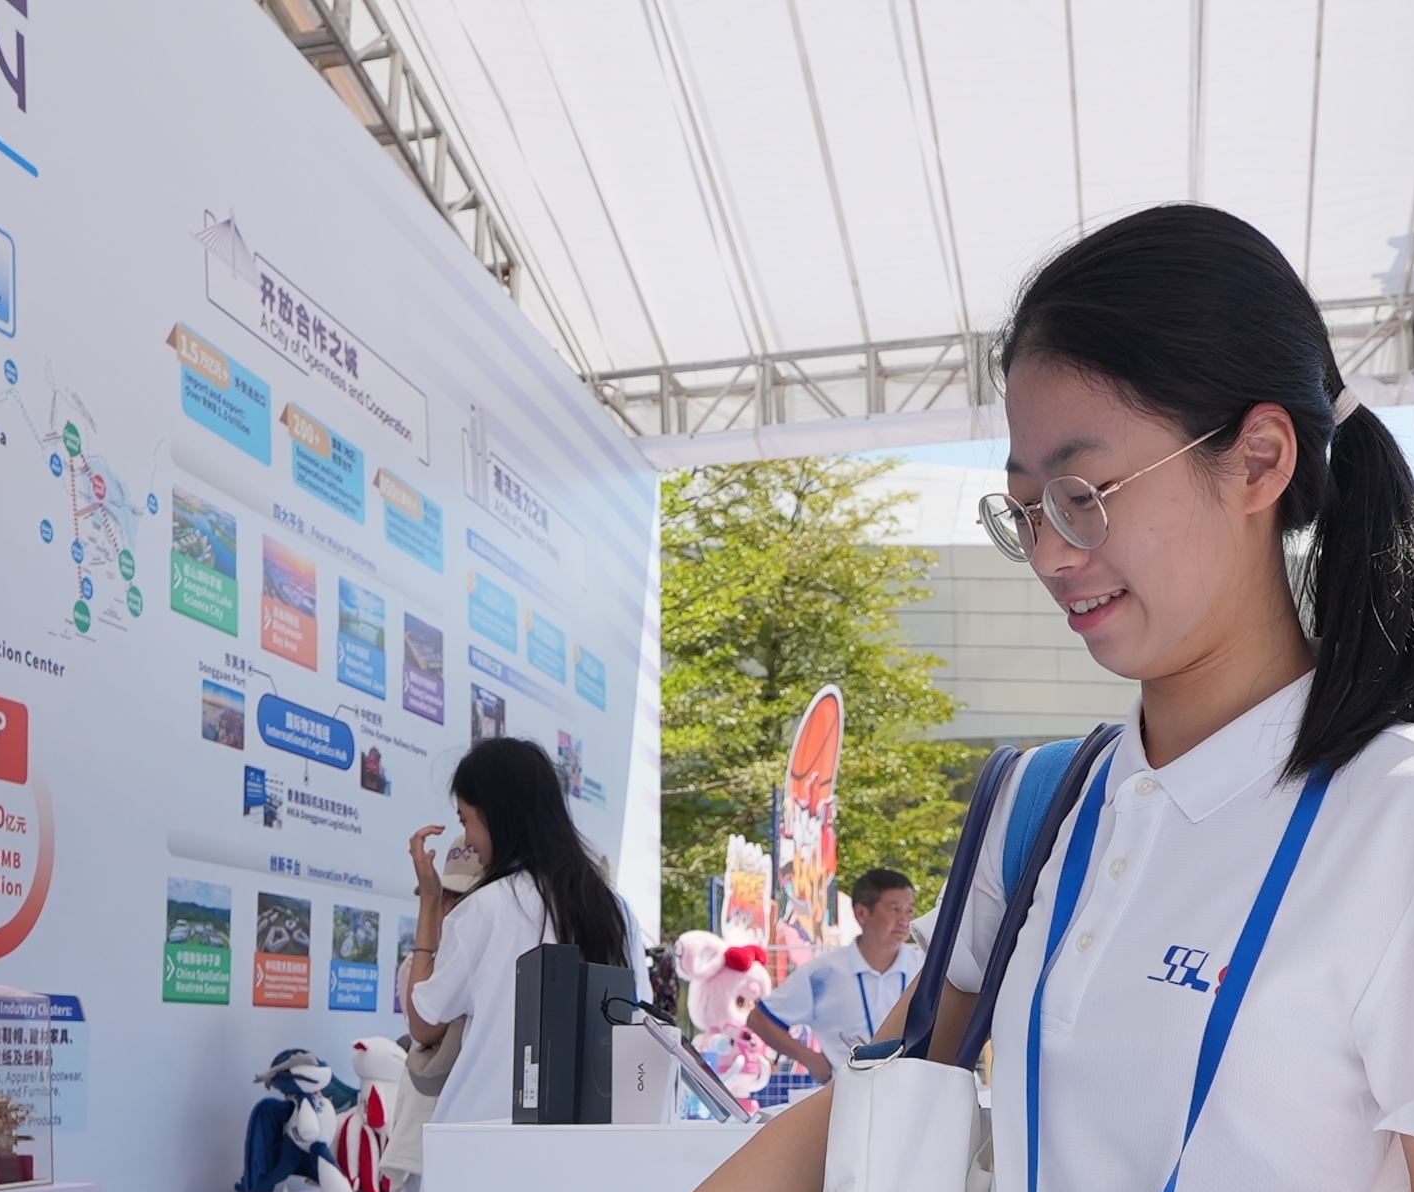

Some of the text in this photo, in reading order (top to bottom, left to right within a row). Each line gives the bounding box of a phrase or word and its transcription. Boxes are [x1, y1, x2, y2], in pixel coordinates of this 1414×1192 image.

[25, 649, 66, 678] Center
[0, 1001, 36, 1019] Industry
[37, 1002, 73, 1017] Clsters:
[46, 1071, 83, 1083] ootwear,
